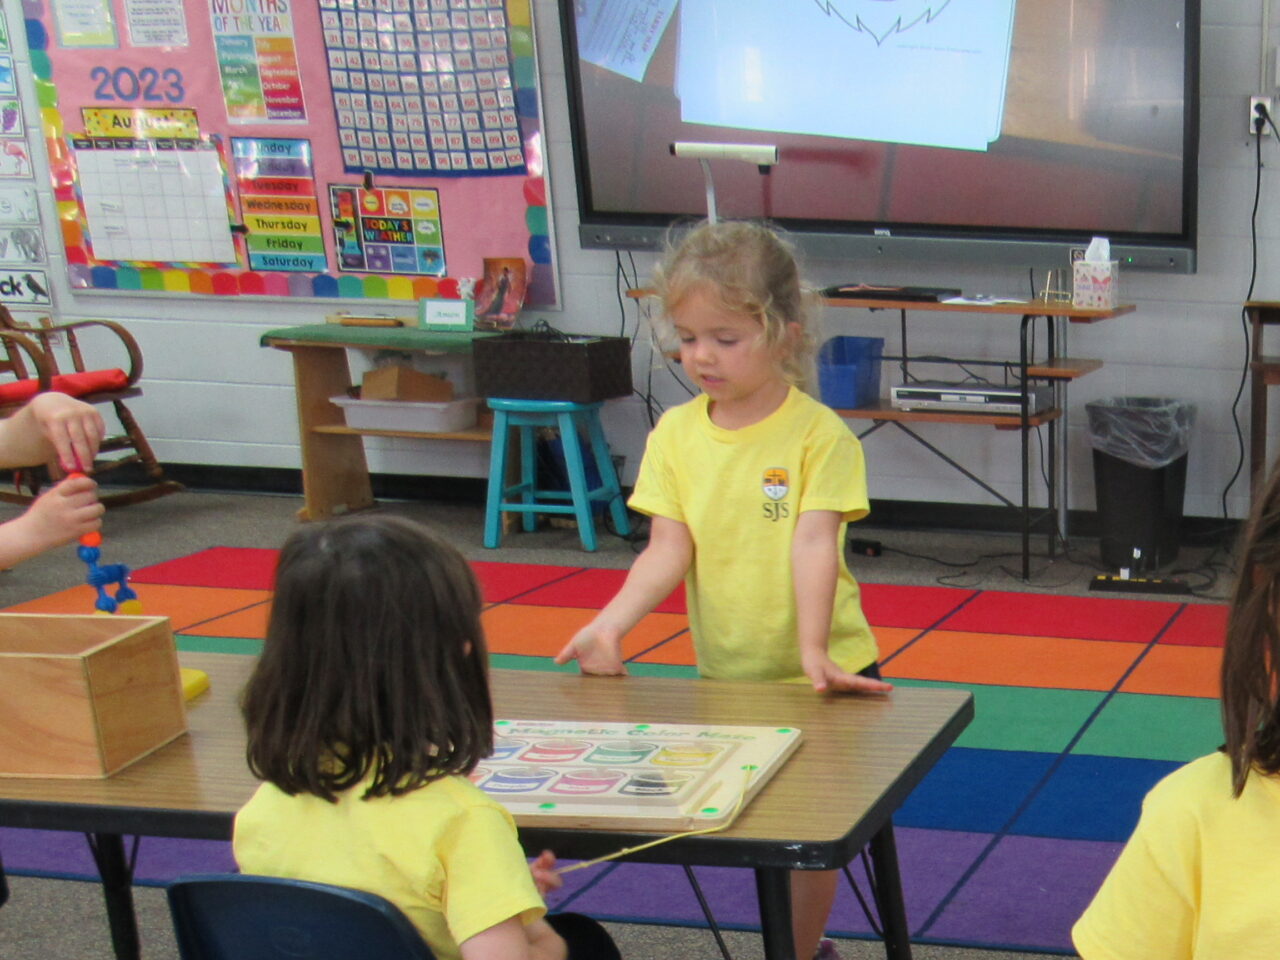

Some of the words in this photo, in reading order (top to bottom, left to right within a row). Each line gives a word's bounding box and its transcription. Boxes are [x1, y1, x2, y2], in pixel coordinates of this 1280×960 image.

[90, 66, 185, 103] 2023
[247, 200, 311, 212] Wednesday
[256, 218, 308, 230] Thursday
[266, 237, 304, 248] Friday
[262, 256, 314, 268] Saturday
[762, 502, 790, 522] SJS
[508, 728, 618, 738] Magnetic
[626, 728, 691, 738] Color
